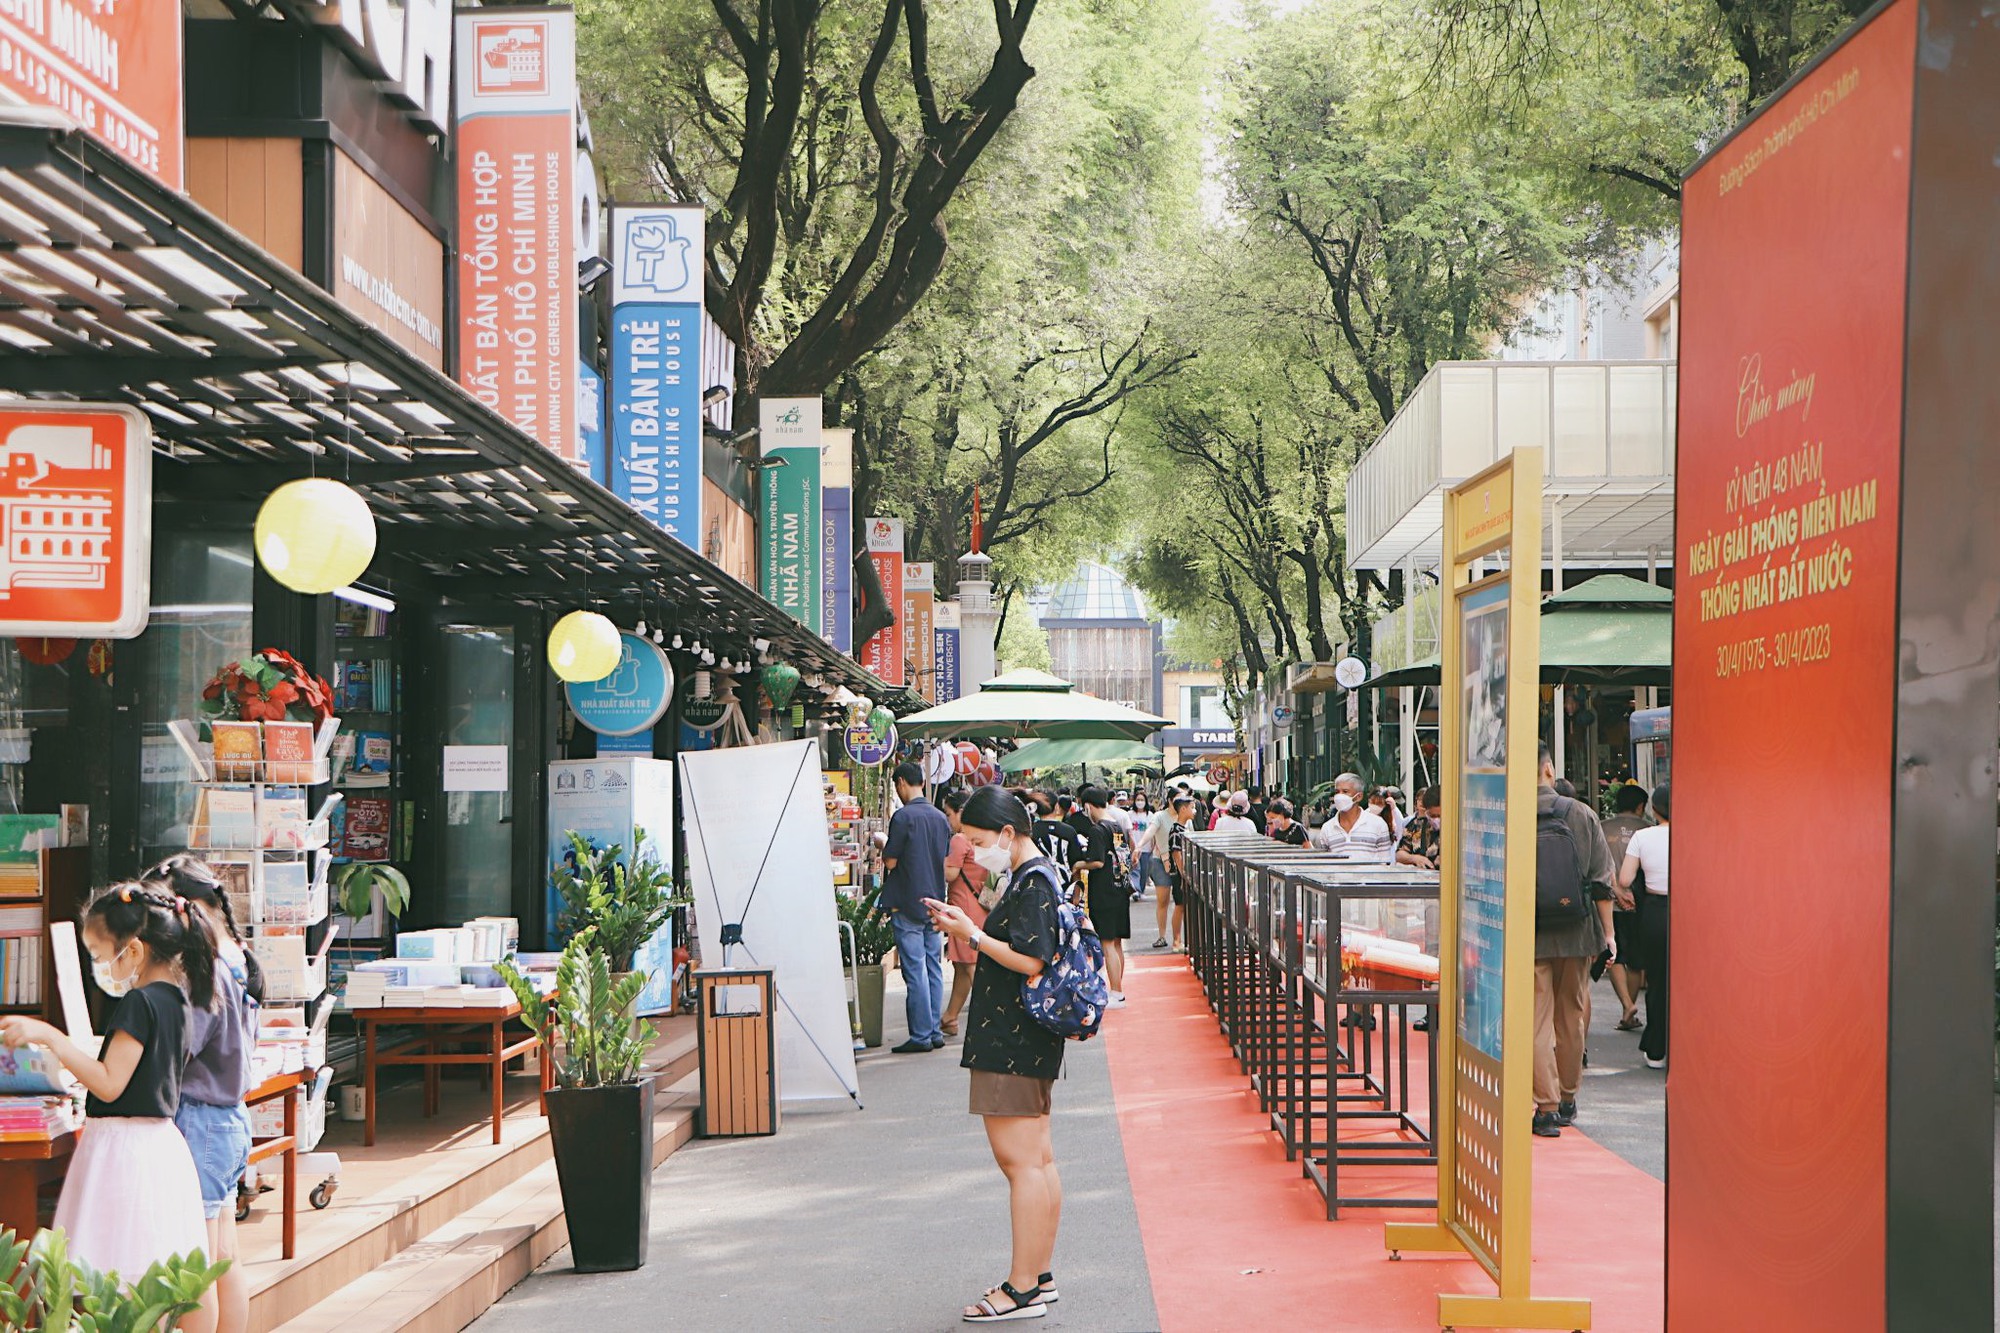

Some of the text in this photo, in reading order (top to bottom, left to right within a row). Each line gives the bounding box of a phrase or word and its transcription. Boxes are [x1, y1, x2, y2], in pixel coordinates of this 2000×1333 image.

[51, 0, 118, 91] MINH
[104, 111, 159, 173] HOUSE
[472, 151, 502, 205] HỢP
[513, 153, 535, 221] MINH
[546, 152, 559, 200] HOUSE
[463, 213, 498, 287] TỔNG
[507, 227, 536, 275] CHÍ
[547, 203, 560, 288] PUBLISHING
[467, 294, 498, 348] BẢN
[504, 281, 537, 320] HỒ
[548, 291, 560, 356] GENERAL
[504, 327, 537, 385] PHỐ
[620, 320, 660, 374] TRẺ
[548, 359, 561, 391] CITY
[1736, 352, 1771, 439] Chào
[548, 394, 561, 435] MINH
[620, 378, 659, 436] BẢN
[665, 319, 681, 533] PUBLISHING HOUSE
[1726, 440, 1823, 514] KỶ NIỆM 48 NĂM
[826, 519, 835, 552] BOOK
[1689, 477, 1877, 577] NGÀY GIẢI PHÓNG MIỀN NAM
[780, 513, 798, 607] NHÃ NAM
[826, 558, 835, 584] NAM
[884, 558, 893, 589] HOUSE
[1700, 539, 1852, 622] THỐNG NHẤT ĐẤT NƯỚC
[803, 569, 811, 607] Publishing
[936, 633, 944, 654] SEN
[945, 633, 954, 688] UNIVERSITY
[1716, 637, 1766, 678] 30/4/1975
[1773, 623, 1831, 668] 30/4/2023
